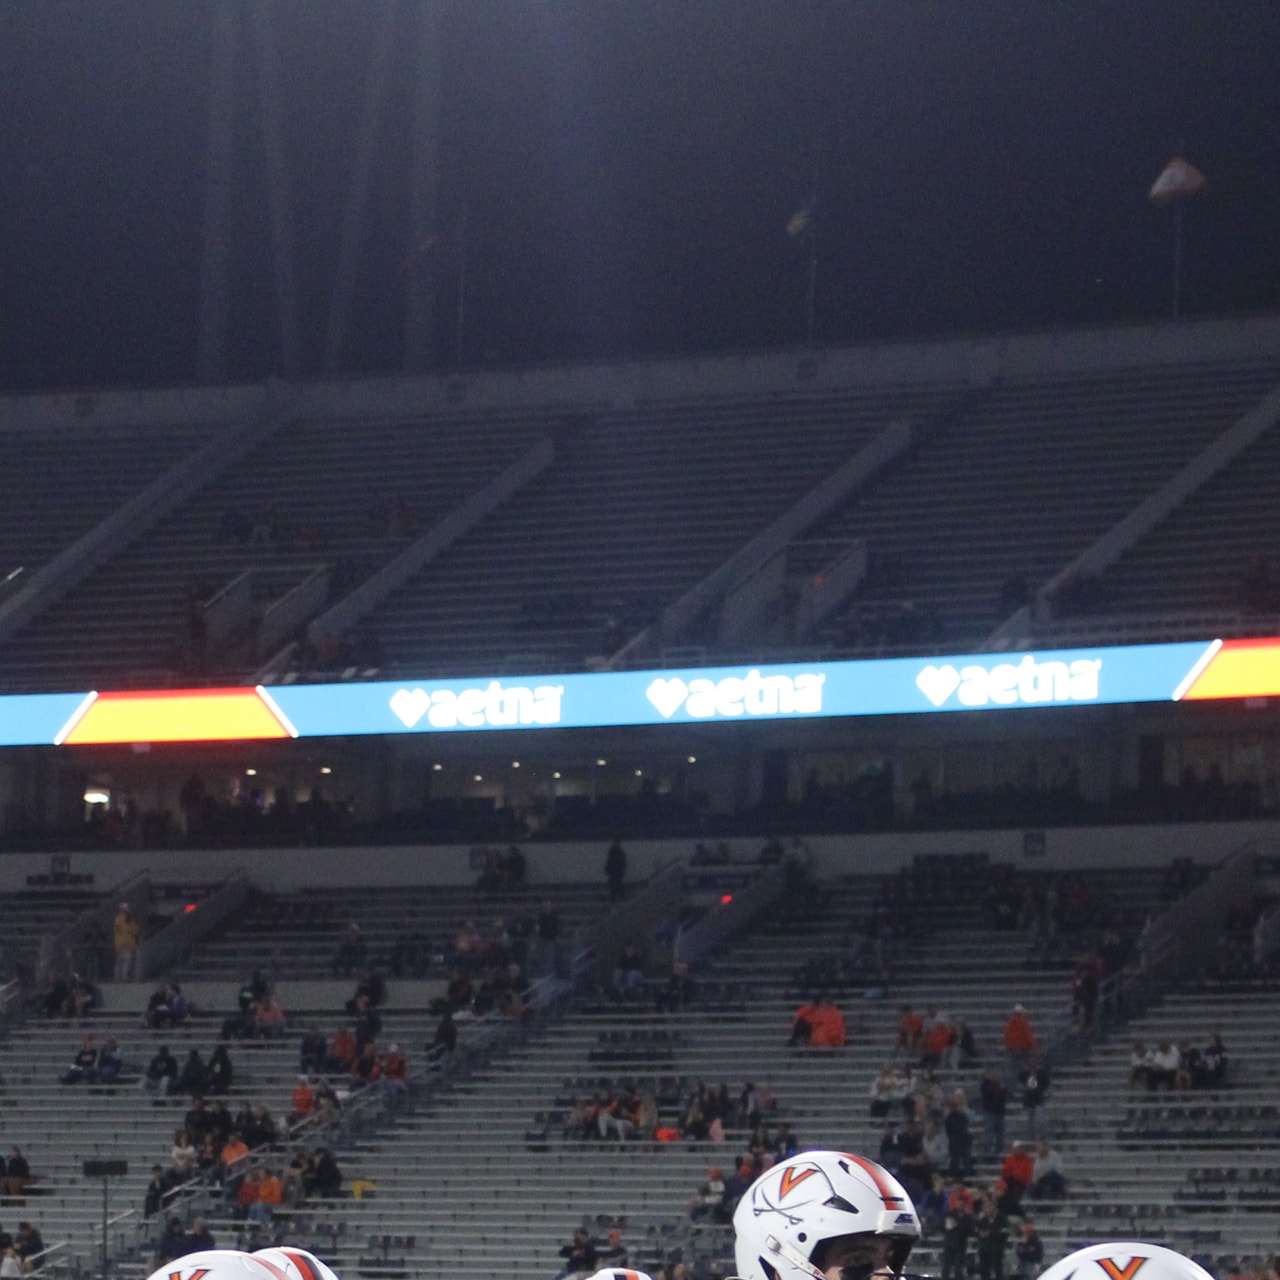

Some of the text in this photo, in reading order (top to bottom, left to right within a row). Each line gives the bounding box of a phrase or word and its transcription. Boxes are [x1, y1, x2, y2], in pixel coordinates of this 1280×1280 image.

[687, 670, 825, 717] aetna
[969, 655, 1101, 703] aetna
[430, 681, 563, 727] aetna
